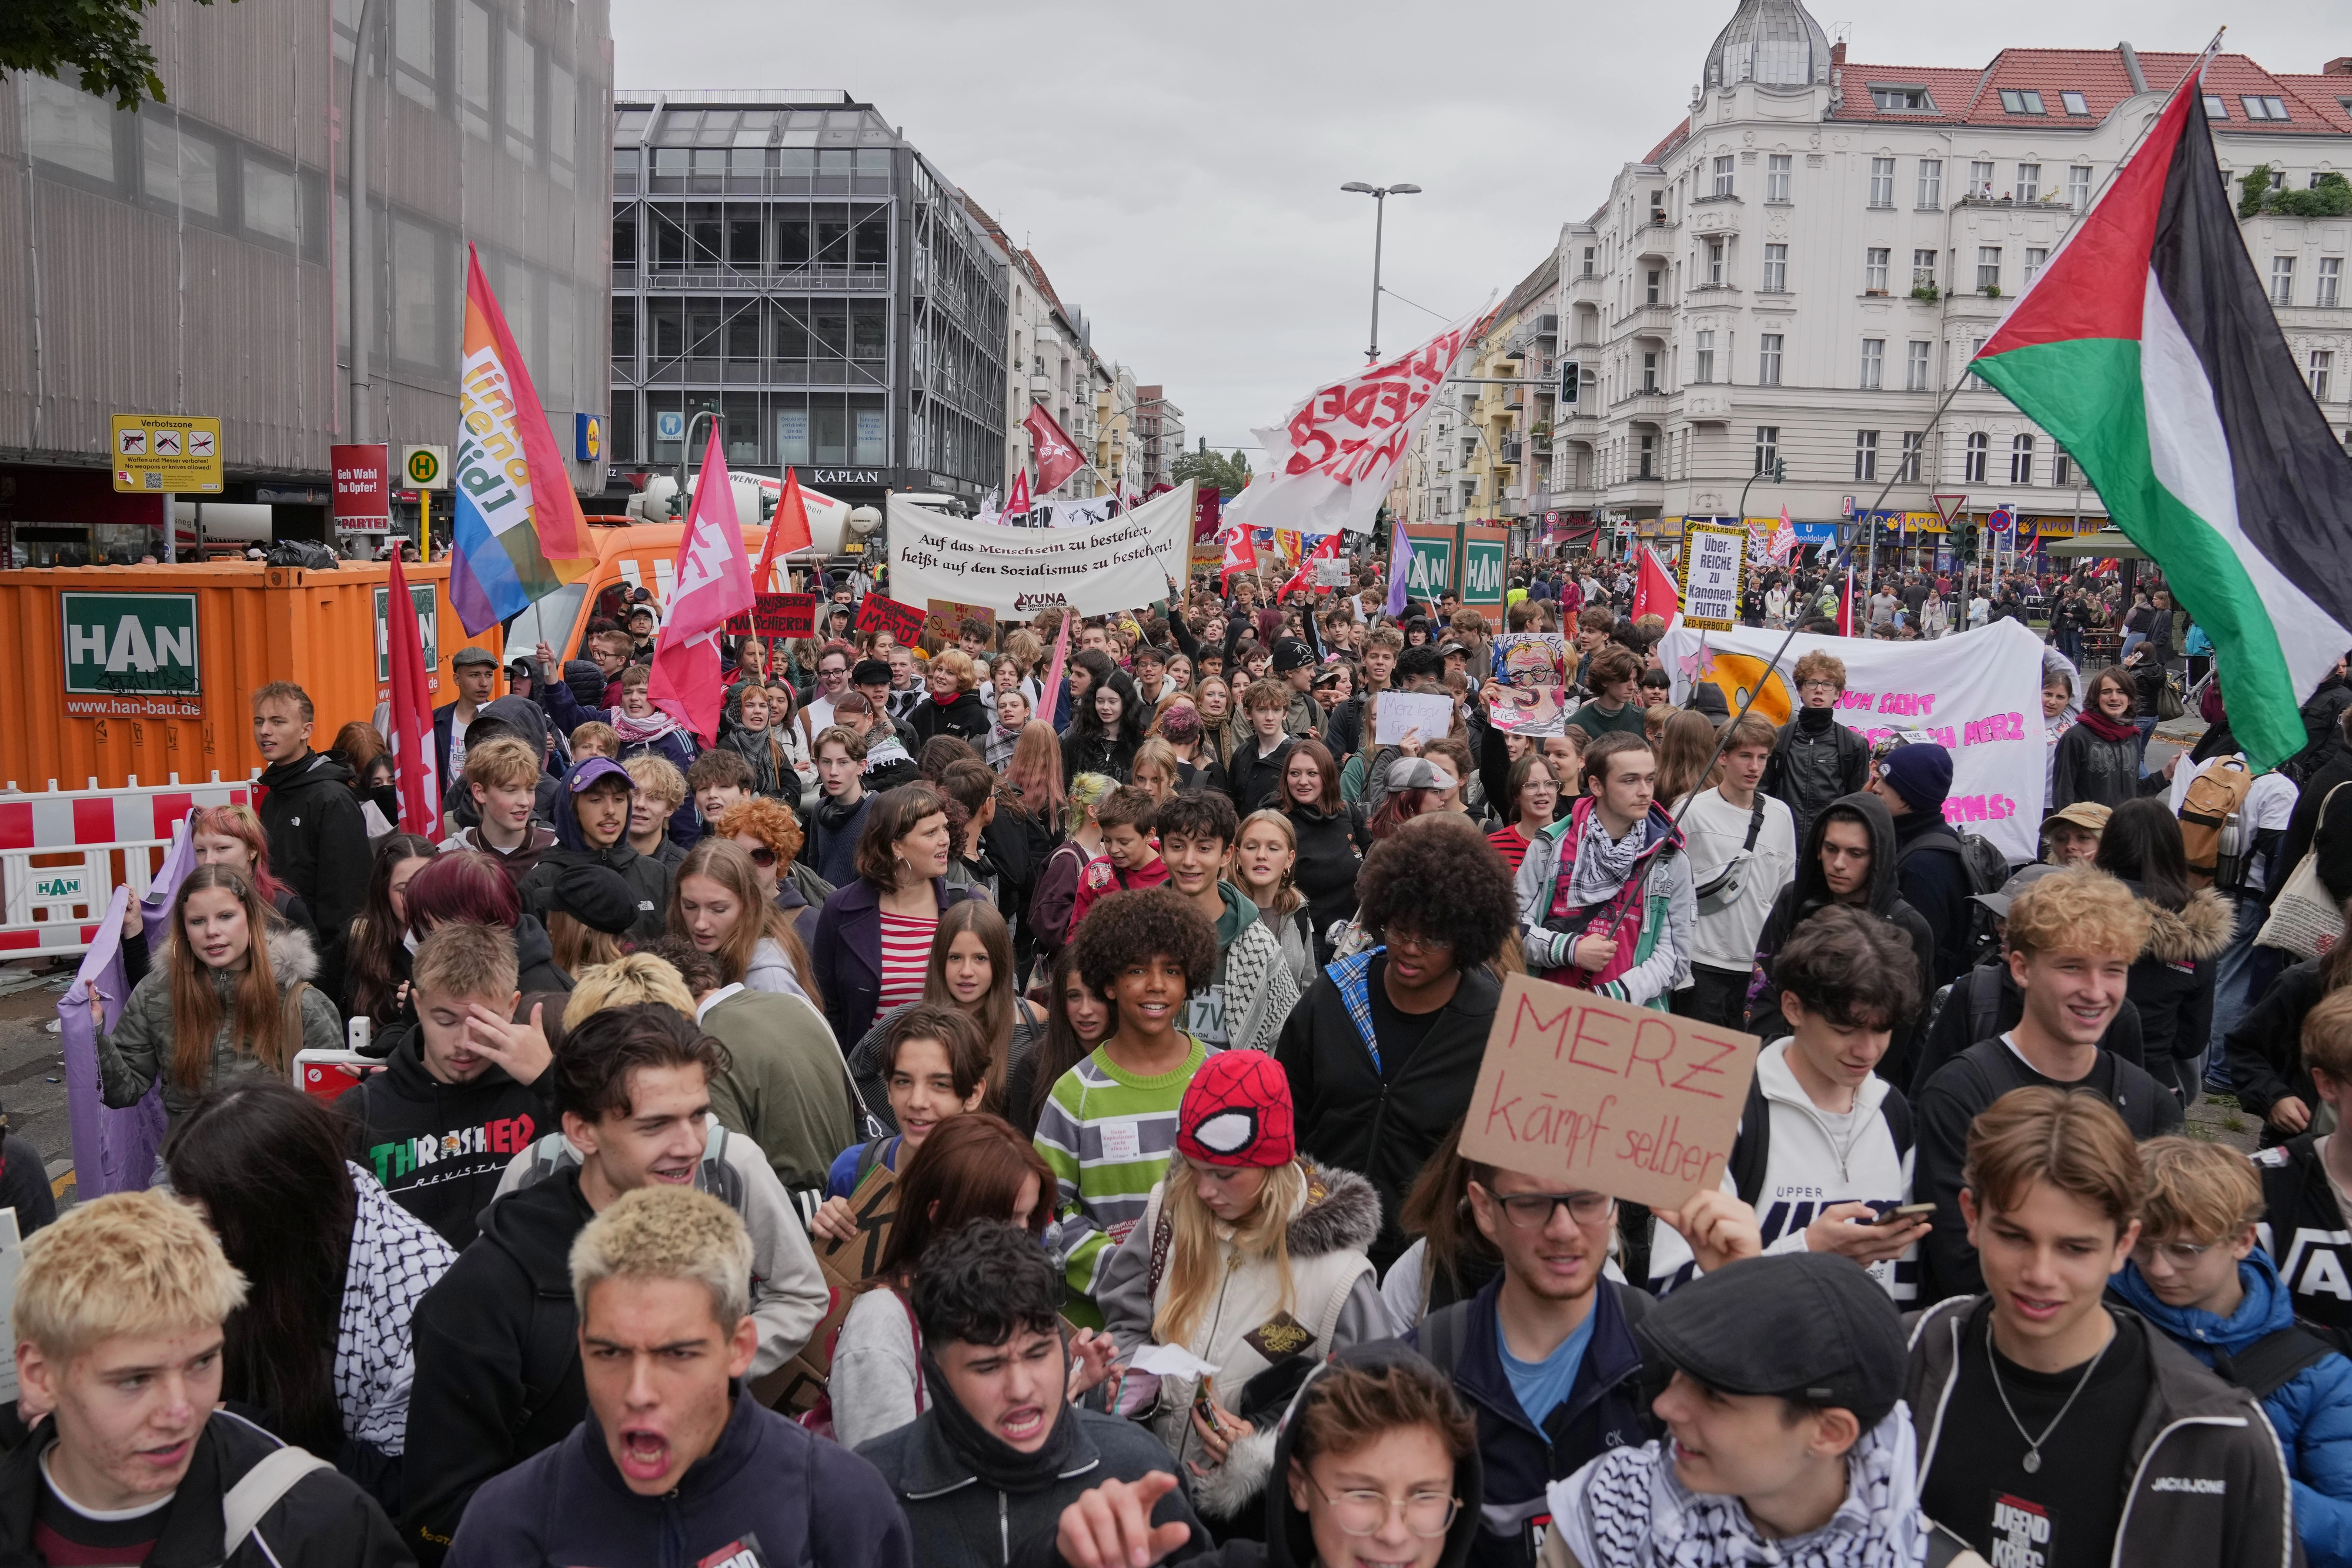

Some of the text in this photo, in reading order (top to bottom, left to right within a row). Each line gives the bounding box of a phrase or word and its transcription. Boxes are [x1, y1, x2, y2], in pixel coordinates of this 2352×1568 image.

[141, 420, 193, 428] Verbotszone
[338, 469, 377, 480] Geh Wahl
[416, 459, 429, 475] H
[729, 475, 761, 486] WENK
[814, 470, 878, 483] KAPLAN
[339, 482, 377, 494] Du Opfer!
[342, 518, 388, 529] PARTEI
[1696, 523, 1748, 536] AFD-VERBOT.DE
[1806, 524, 1813, 533] U
[918, 524, 1151, 555] Auf das Menschsein zu bestehen,
[1705, 535, 1731, 551] Über-
[901, 539, 1172, 576] heißt auf den Sozialismus zu bestehen!
[1318, 560, 1338, 569] WEHR
[1679, 531, 1693, 594] AFD-VERBOT.DE
[1700, 554, 1732, 570] REICHE
[1467, 553, 1501, 591] HAN
[1736, 539, 1748, 601] AFD-VERBOT.DE
[1024, 593, 1067, 604] YUNA
[1688, 584, 1735, 600] Kanonen-
[955, 603, 969, 614] Wir
[1695, 602, 1727, 617] FUTTER
[860, 611, 913, 643] MORD
[1683, 618, 1732, 632] AFD-VERBOT.DE
[69, 615, 192, 671] HAN
[68, 700, 201, 716] www.han-bau.de
[1384, 697, 1439, 717] Merz leck
[1964, 712, 2024, 745] MERZ
[36, 878, 81, 896] HAN
[1508, 992, 1737, 1098] MERZ
[369, 1113, 535, 1186] THRASHER
[1616, 1115, 1725, 1184] selber
[416, 1162, 496, 1186] REVISTA
[1776, 1186, 1823, 1198] UPPER
[1605, 1429, 1625, 1447] CK
[1992, 1502, 2050, 1544] JUGEND
